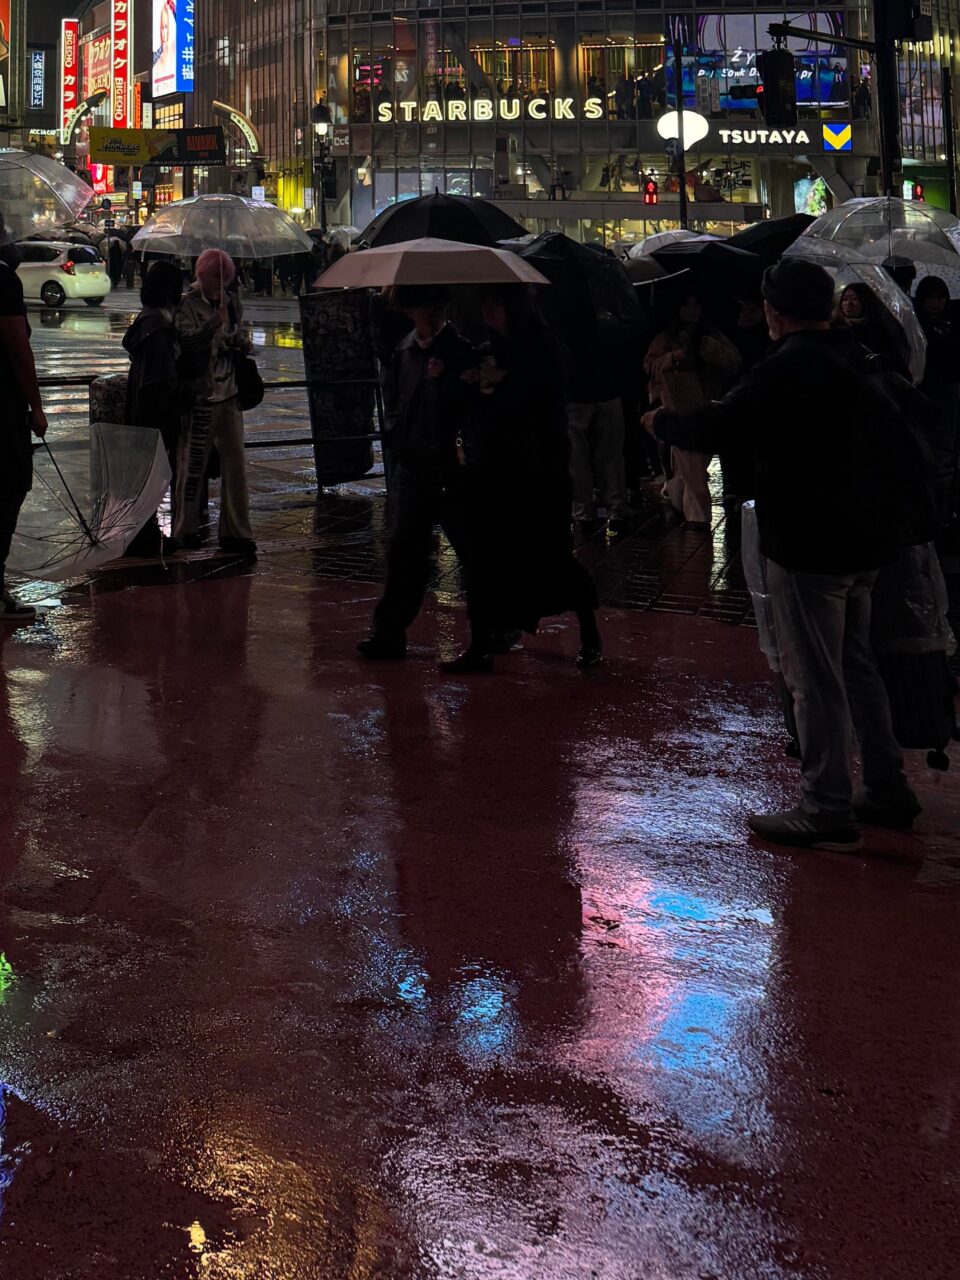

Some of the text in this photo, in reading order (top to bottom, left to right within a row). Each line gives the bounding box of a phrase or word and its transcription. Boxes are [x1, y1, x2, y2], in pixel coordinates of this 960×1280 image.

[114, 1, 128, 70] カラオケ
[377, 97, 604, 123] STARBUCKS
[718, 129, 810, 145] TSUTAYA
